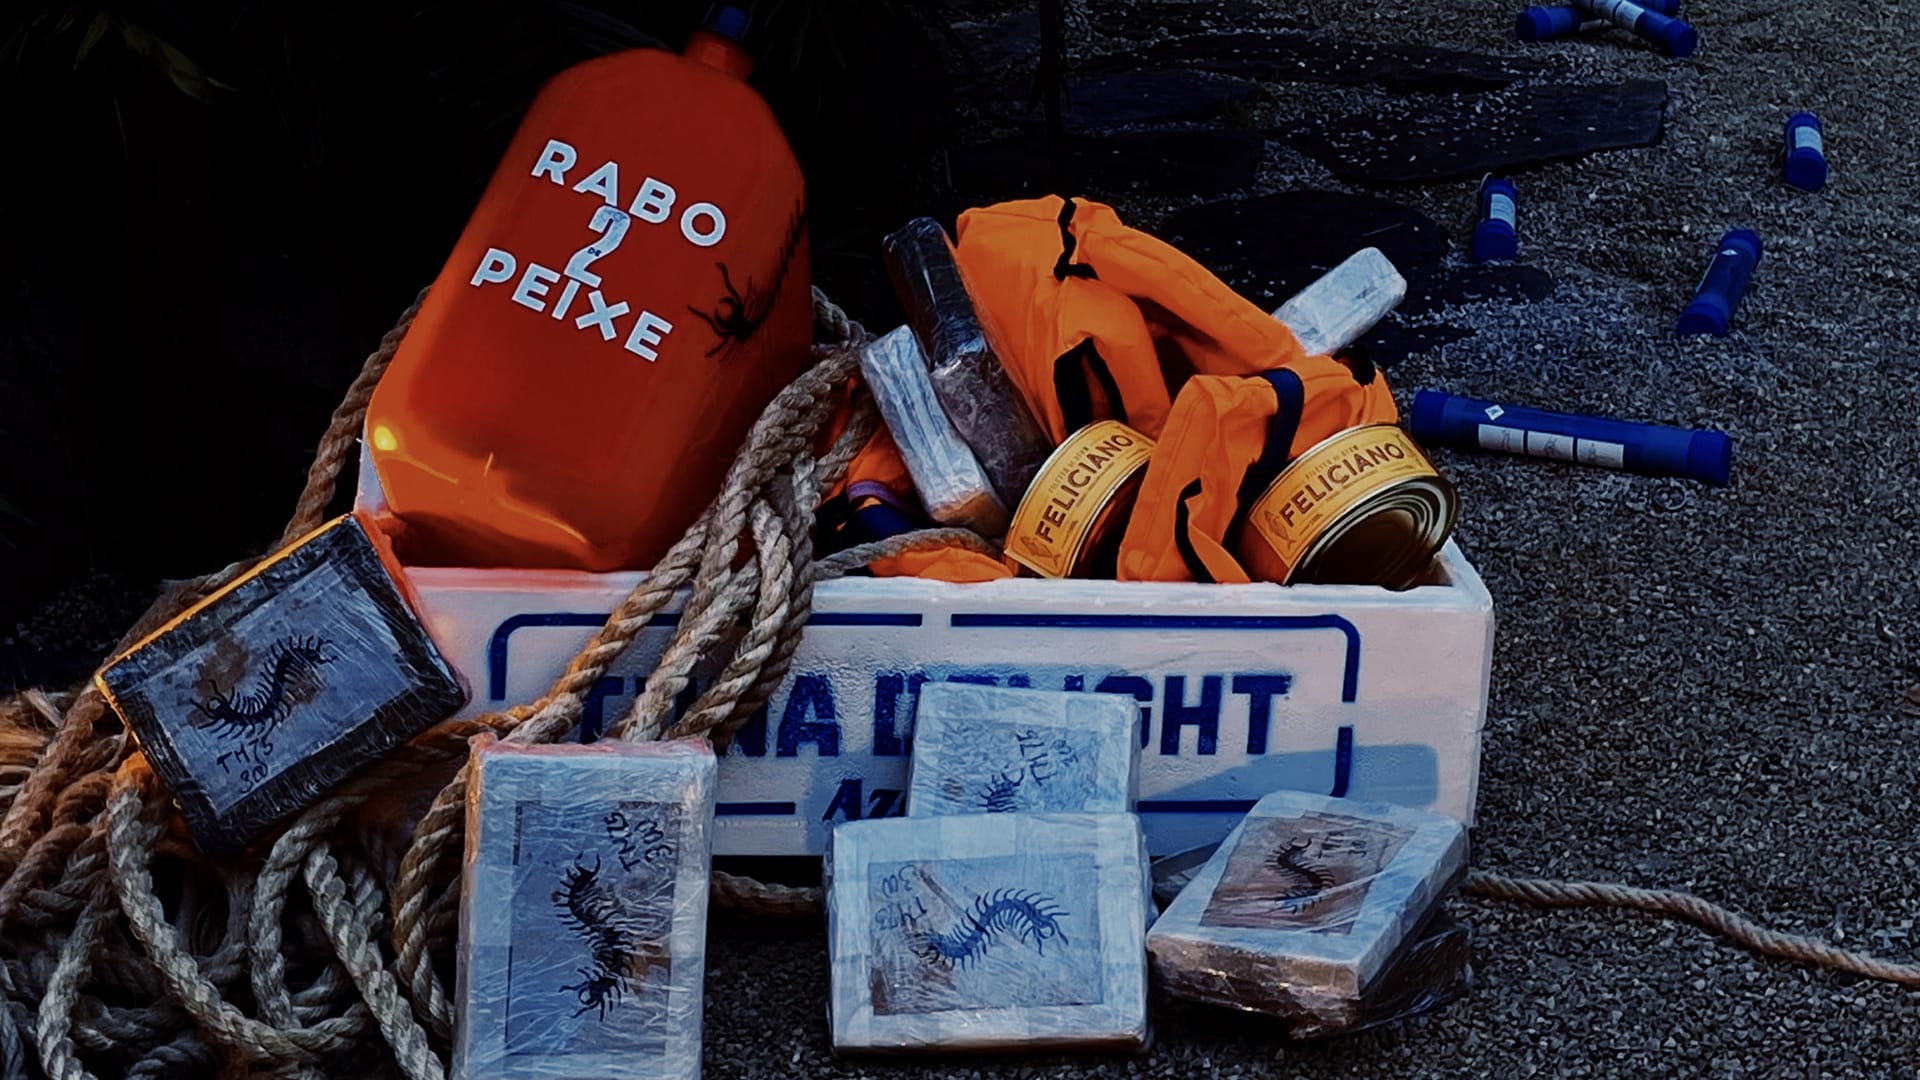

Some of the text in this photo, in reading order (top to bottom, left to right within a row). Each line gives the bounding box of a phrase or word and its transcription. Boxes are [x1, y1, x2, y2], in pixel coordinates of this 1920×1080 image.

[531, 139, 726, 247] RABO
[563, 204, 631, 289] 2
[470, 247, 673, 362] PEIXE
[1035, 434, 1134, 544] FELICIANO
[1279, 442, 1405, 527] FELICIANO
[578, 672, 840, 757] TA
